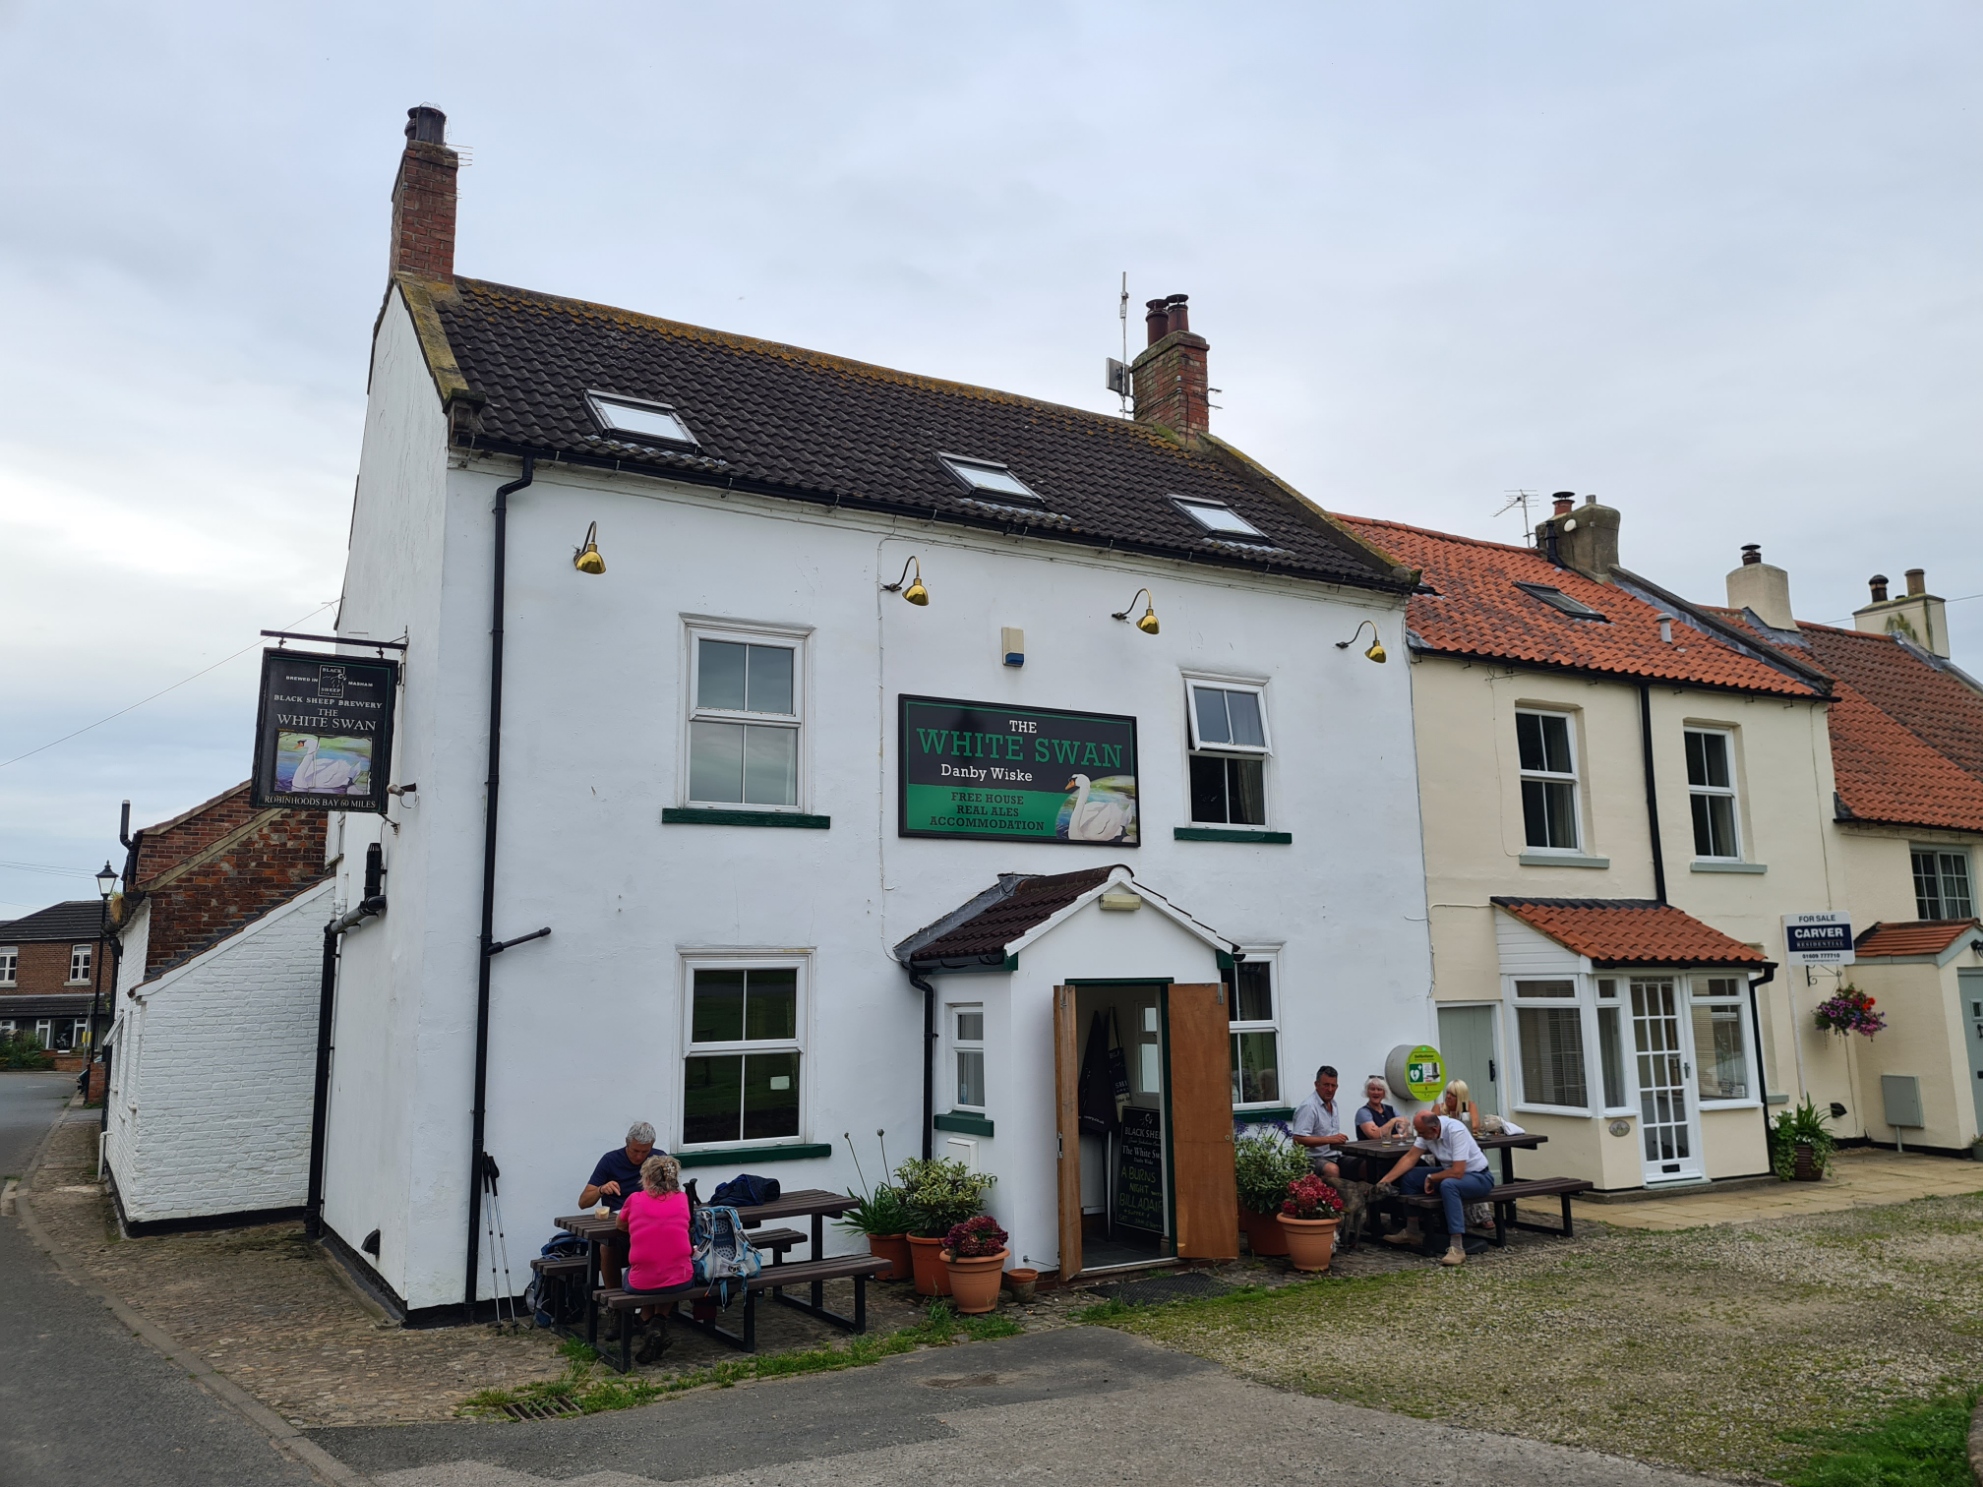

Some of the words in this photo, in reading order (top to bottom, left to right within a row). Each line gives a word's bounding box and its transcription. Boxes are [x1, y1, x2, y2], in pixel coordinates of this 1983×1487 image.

[274, 694, 303, 703] BLACK
[338, 701, 383, 709] BREWERY
[318, 708, 338, 717] THE
[277, 714, 328, 728] WHITE
[332, 718, 376, 731] SWAN
[1009, 719, 1037, 734] THE
[916, 728, 1024, 761] WHITE
[1035, 737, 1123, 769] SWAN
[940, 763, 987, 782] Danby
[990, 767, 1033, 782] Wiske
[264, 795, 320, 806] ROBINHOODS
[322, 798, 338, 807] BAY
[340, 799, 350, 807] 60
[350, 800, 376, 808] MILES
[951, 791, 983, 804] FREE
[985, 794, 1024, 805] HOUSE
[956, 805, 988, 816] REAL
[990, 806, 1019, 817] ALES
[929, 816, 1045, 831] ACCOMMODATION
[1798, 915, 1815, 923] FOR
[1815, 914, 1836, 922] SALE
[1794, 927, 1844, 939] CARVER
[1796, 940, 1844, 948] RESIDENTIAL
[1124, 1126, 1145, 1138] BLACK
[1122, 1144, 1133, 1156] The
[1134, 1146, 1151, 1159] White
[1121, 1165, 1127, 1179] A
[1129, 1166, 1156, 1184] BURNS
[1129, 1182, 1149, 1195] NIGHT
